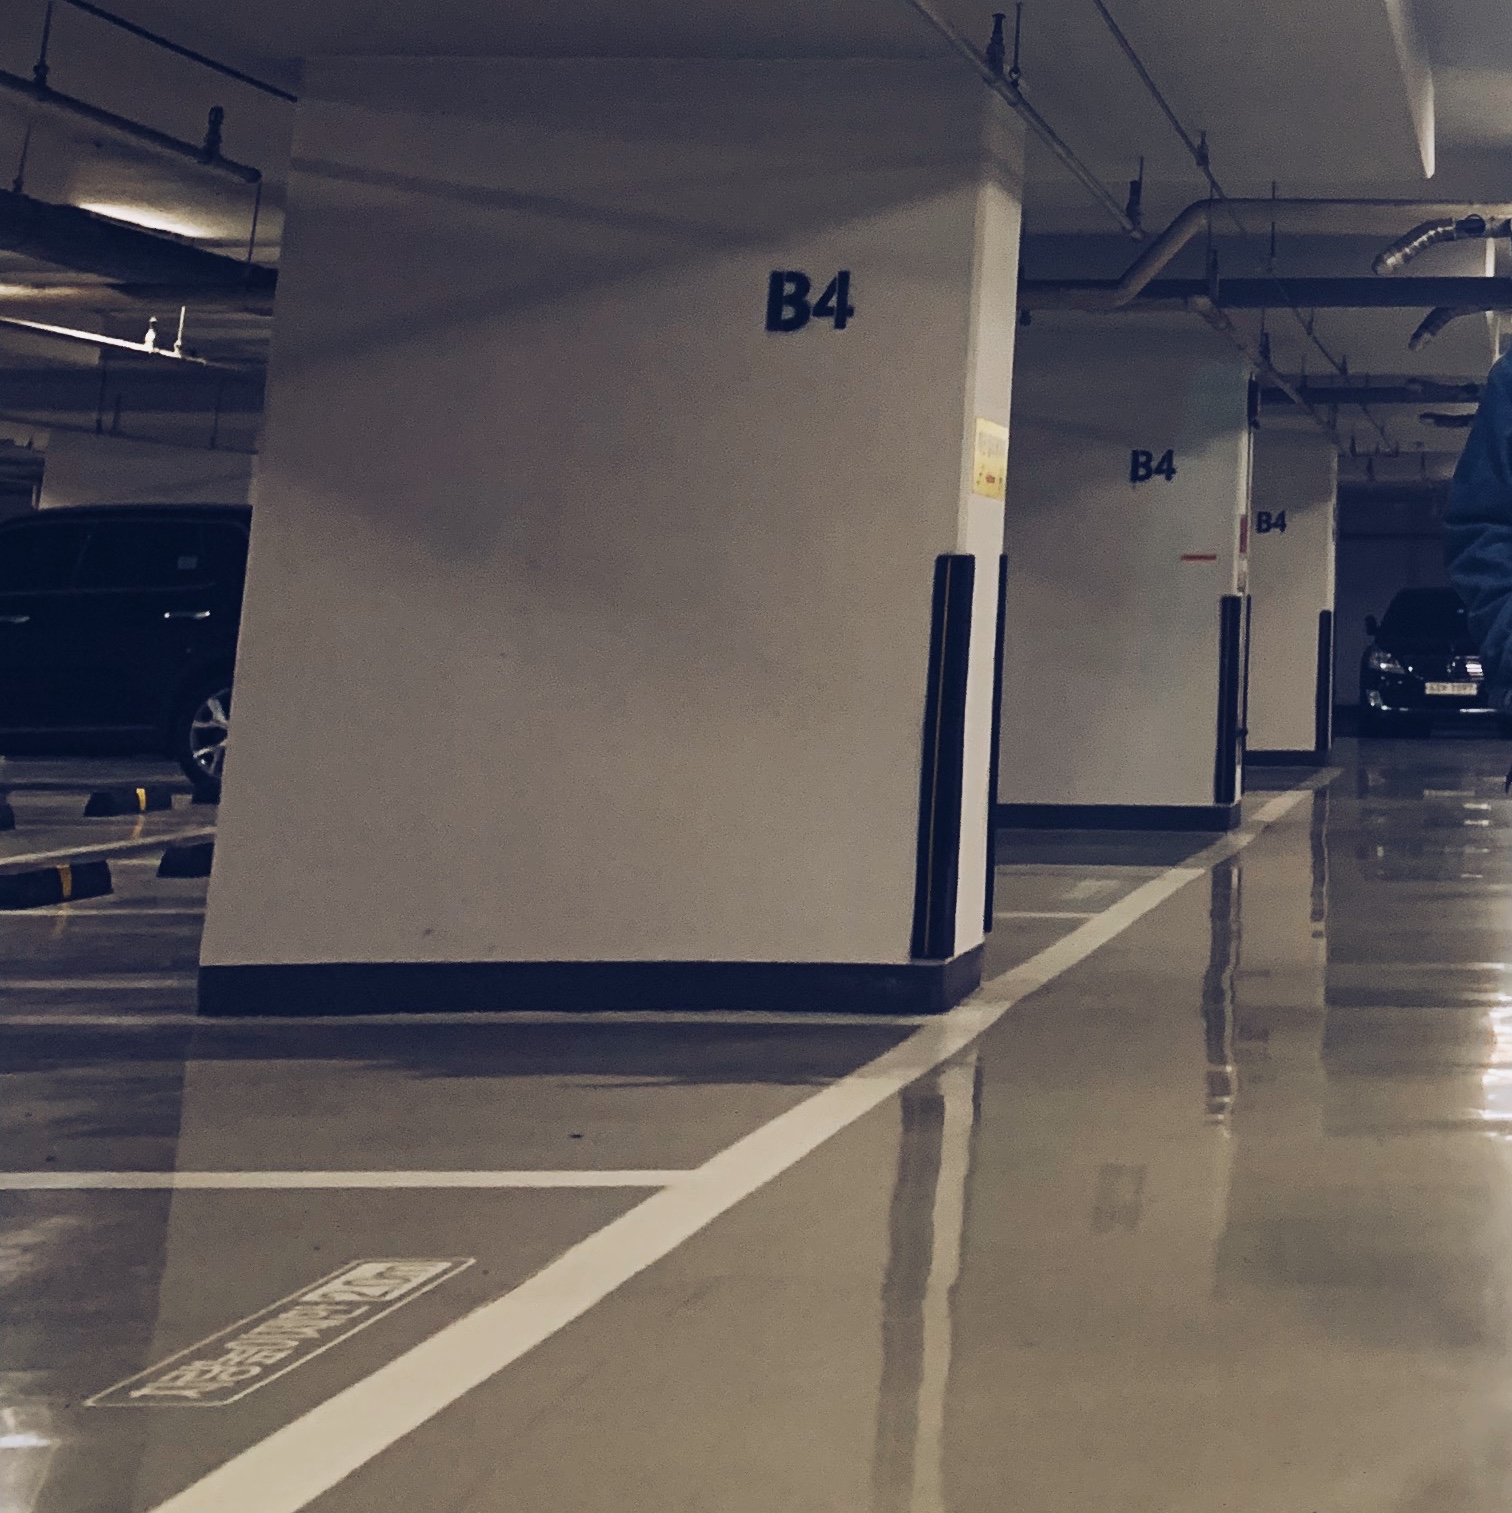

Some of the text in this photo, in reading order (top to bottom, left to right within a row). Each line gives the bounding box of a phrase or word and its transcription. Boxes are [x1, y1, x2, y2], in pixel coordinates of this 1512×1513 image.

[766, 270, 854, 333] B4
[1130, 449, 1177, 483] B4
[1255, 511, 1287, 534] B4
